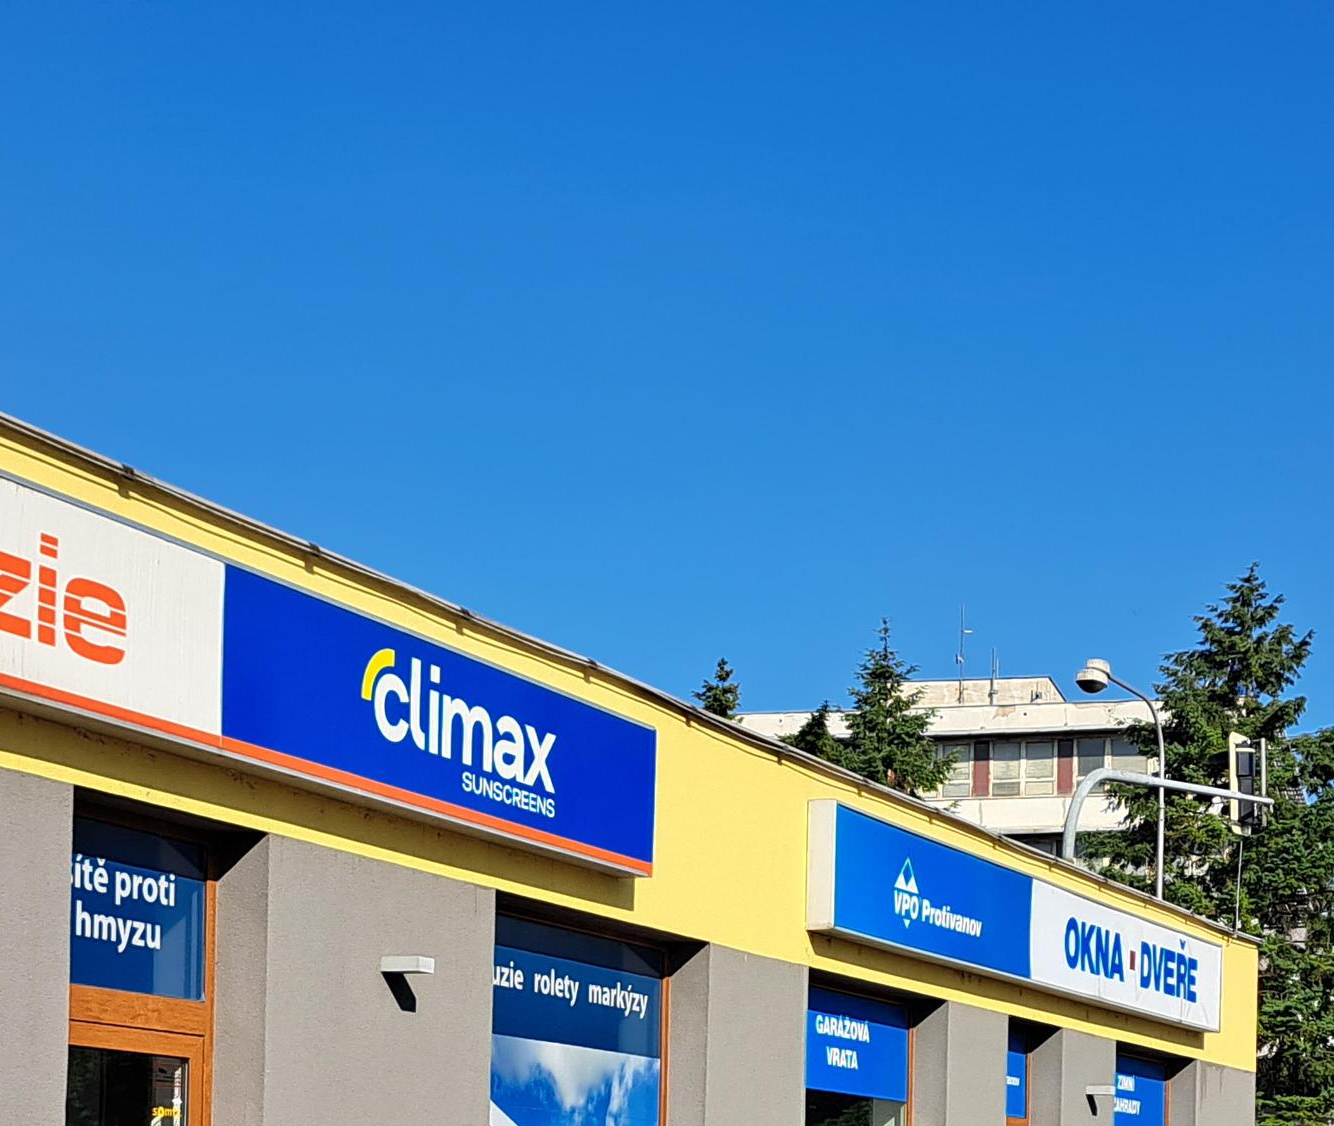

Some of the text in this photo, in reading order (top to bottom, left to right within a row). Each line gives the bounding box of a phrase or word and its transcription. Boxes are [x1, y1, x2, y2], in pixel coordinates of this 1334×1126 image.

[372, 655, 557, 794] climax
[461, 771, 556, 819] SUNSCREENS
[71, 853, 176, 907] ítě proti
[75, 899, 161, 954] hmyzu
[893, 889, 983, 937] VPO Protivanov
[1064, 916, 1198, 1003] OKNA DVEŘE
[533, 968, 580, 1007] rolety
[588, 983, 649, 1019] markýzy
[815, 1014, 870, 1044] GARÁŽOVÁ
[826, 1045, 859, 1070] VRATA
